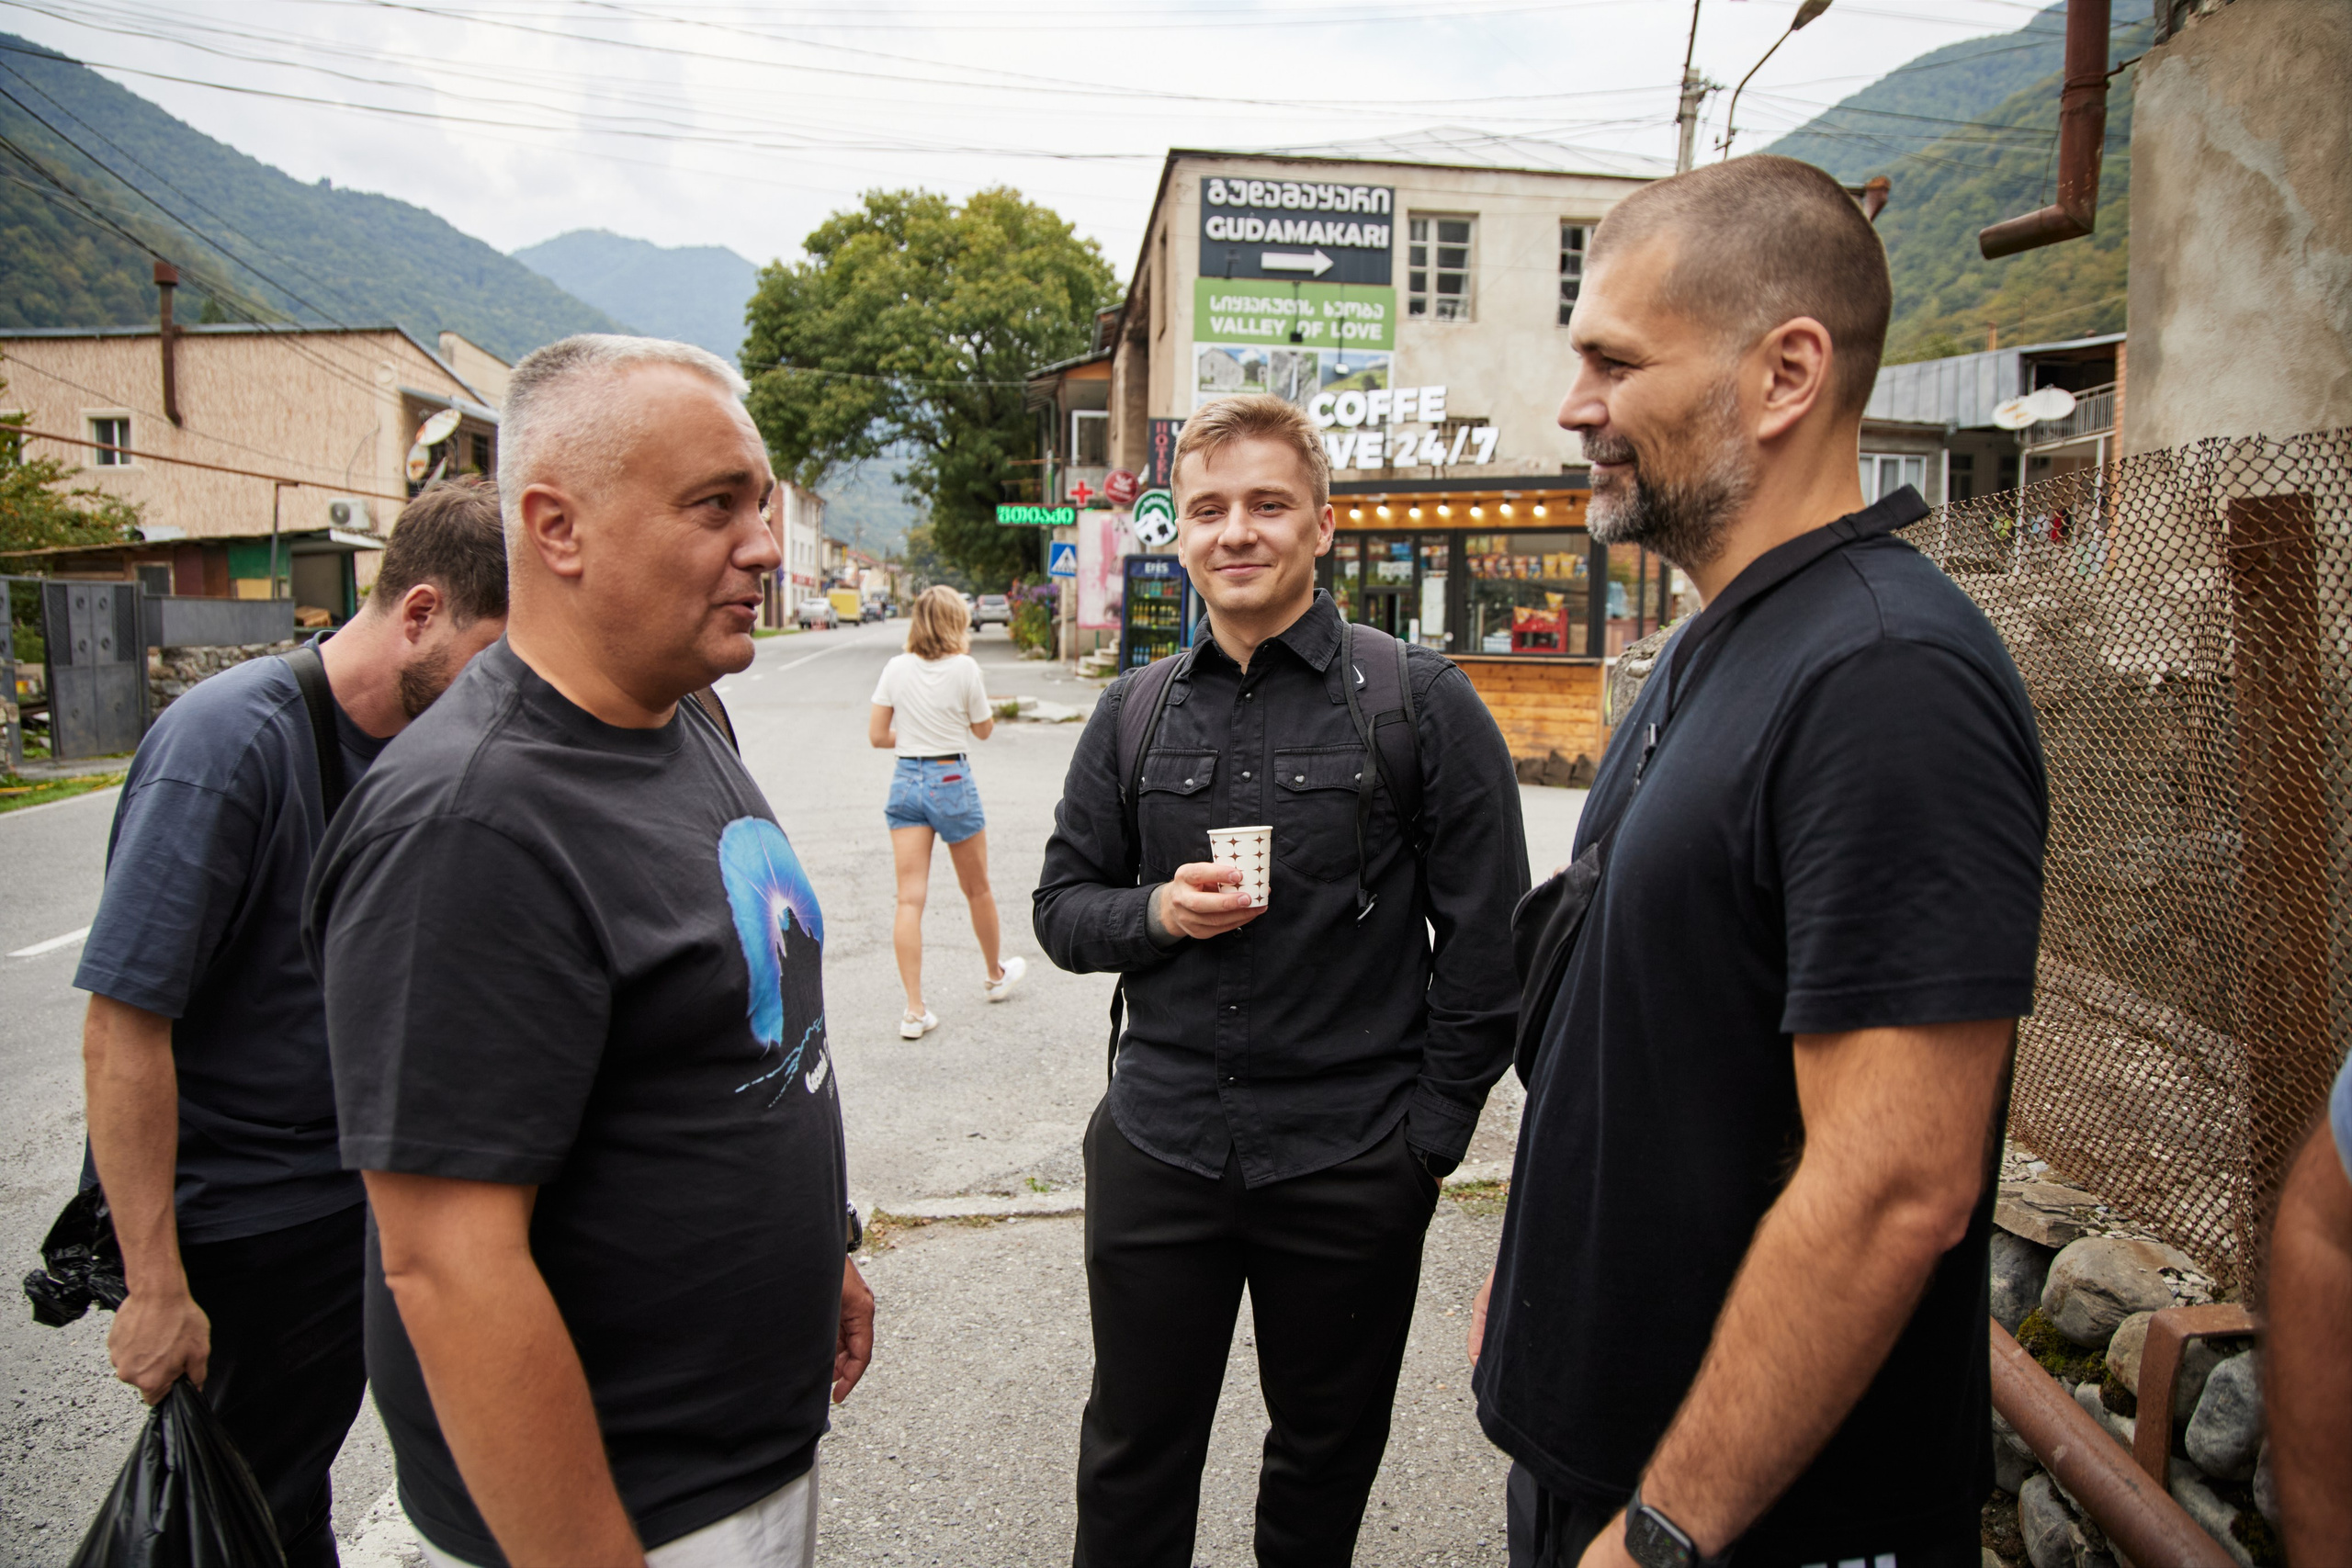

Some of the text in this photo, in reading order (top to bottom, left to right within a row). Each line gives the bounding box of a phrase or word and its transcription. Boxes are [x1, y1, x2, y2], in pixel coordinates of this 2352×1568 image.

[1205, 216, 1390, 248] GUDAMAKARI
[1210, 316, 1383, 340] VALLEY OF LOVE
[1308, 385, 1447, 428] COFFE
[1155, 422, 1169, 485] HOTEL
[1393, 425, 1499, 468] 24/7
